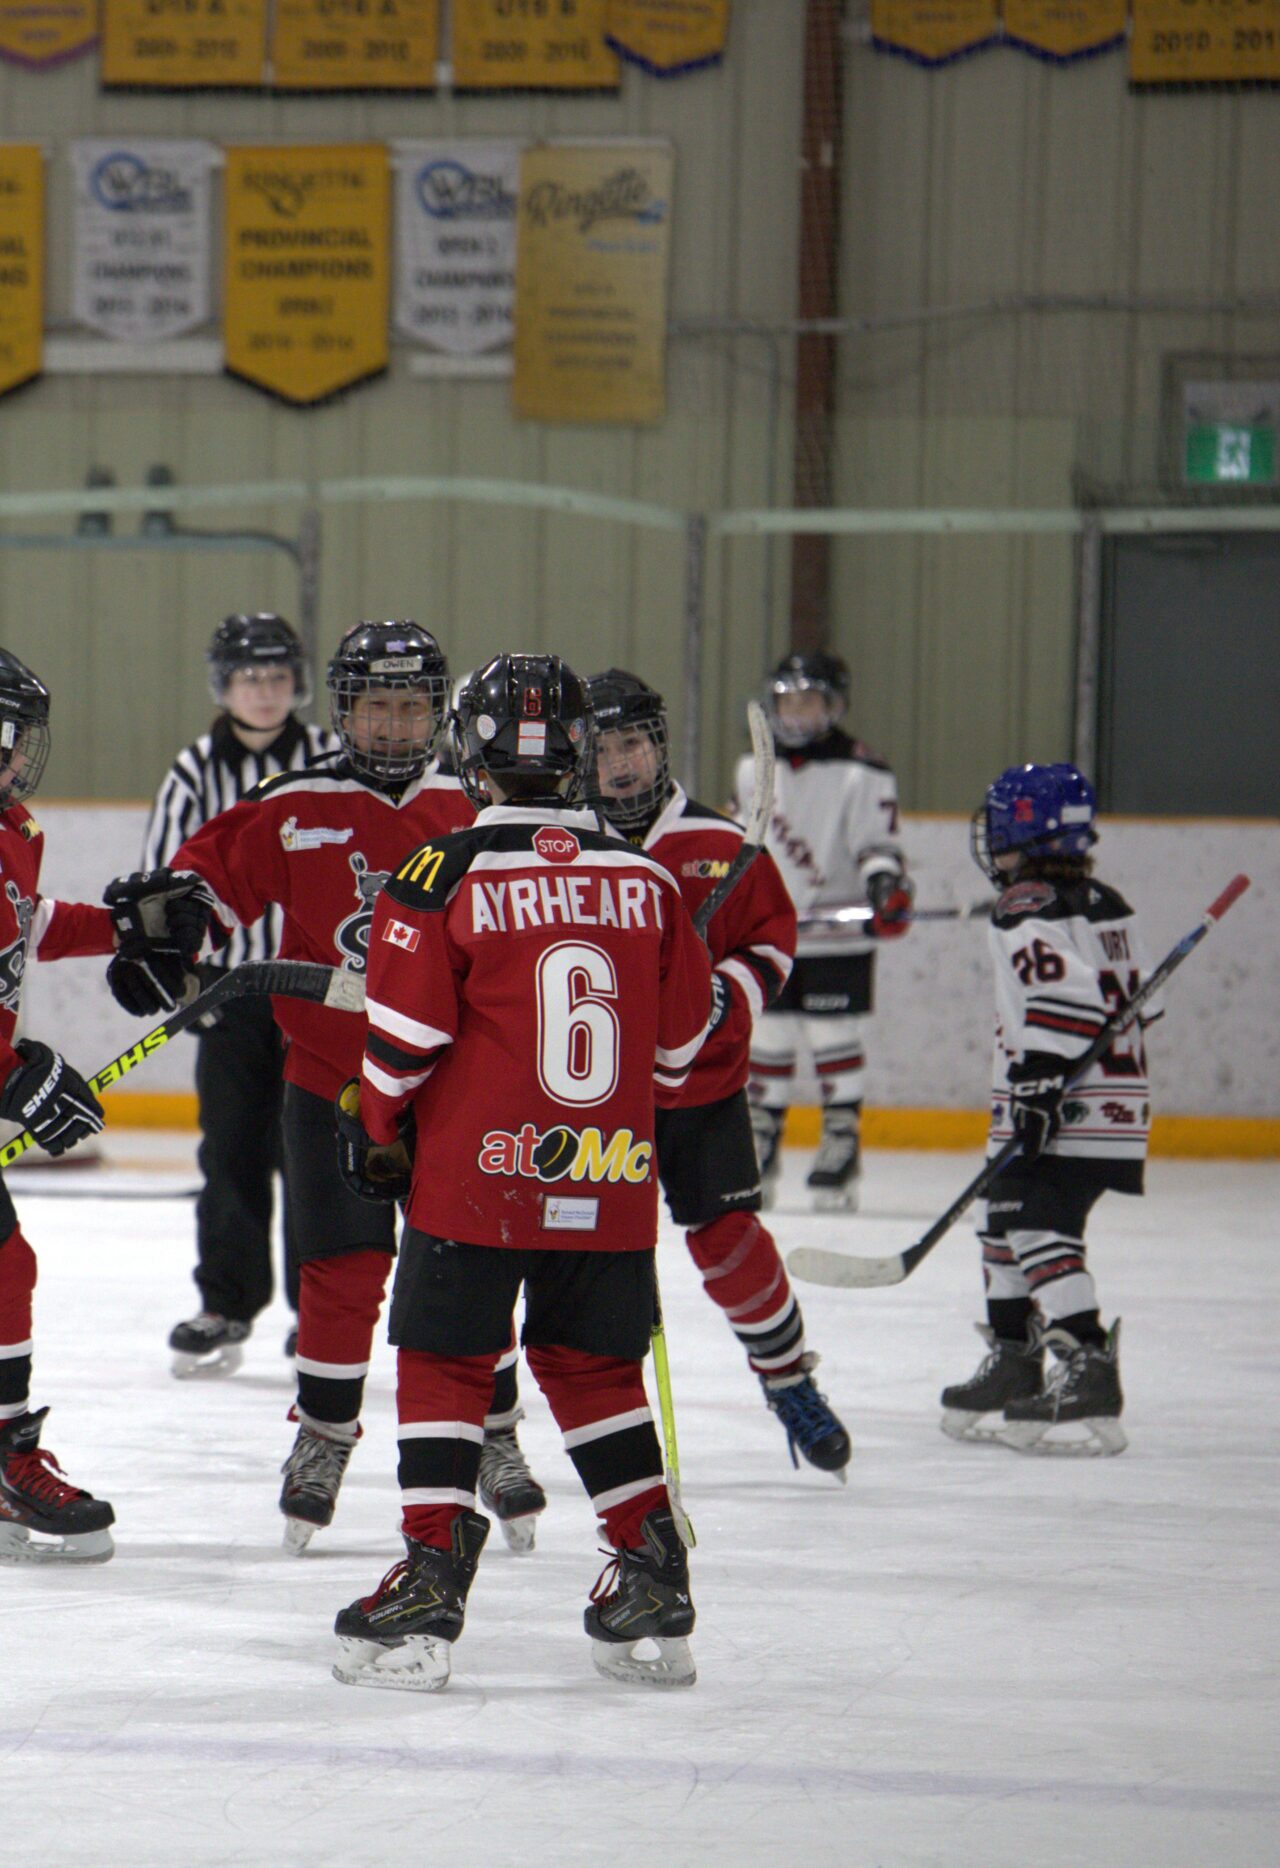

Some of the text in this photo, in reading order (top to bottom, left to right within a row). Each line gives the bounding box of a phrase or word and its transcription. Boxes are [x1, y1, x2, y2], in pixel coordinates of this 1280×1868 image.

[1152, 30, 1210, 53] 2010
[239, 227, 373, 248] PROVINCIAL
[240, 258, 372, 279] CHAMPIONS
[402, 659, 435, 670] OWEN
[538, 839, 575, 853] STOP
[472, 876, 664, 934] AYRHEART
[535, 939, 620, 1108] 6
